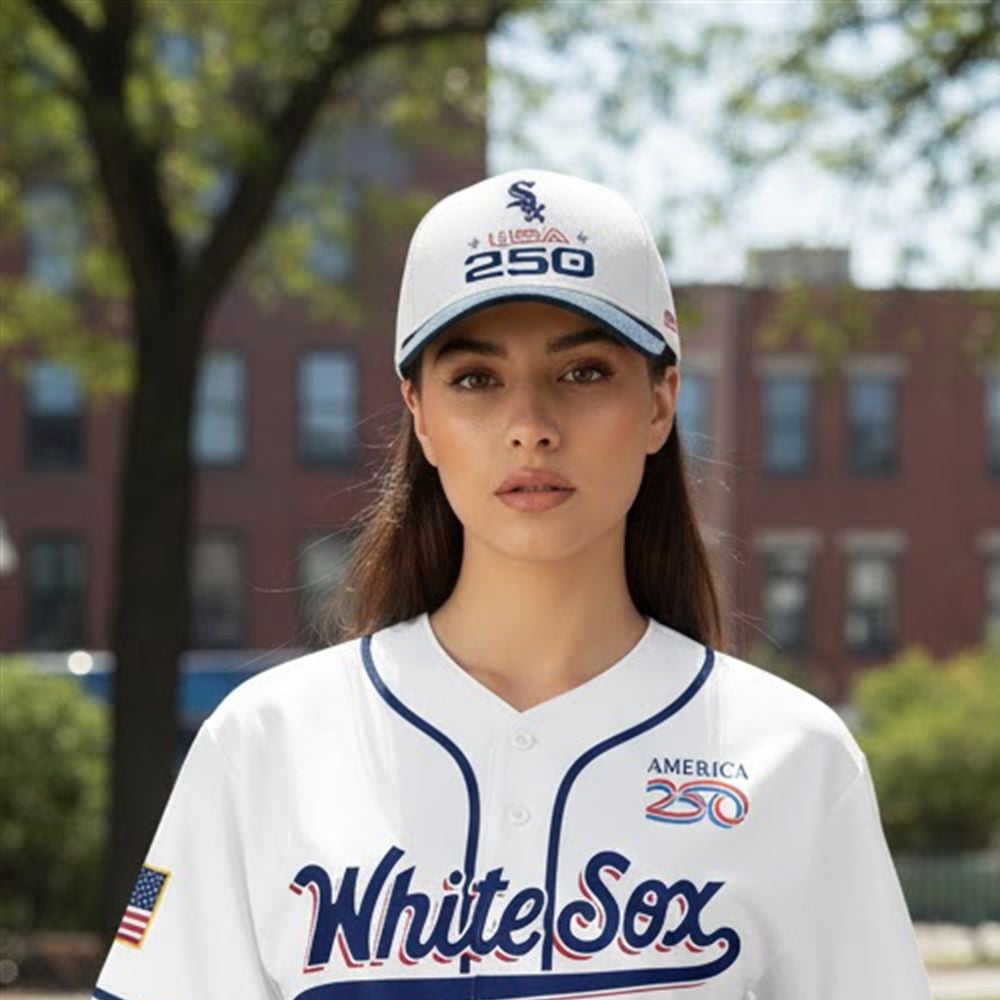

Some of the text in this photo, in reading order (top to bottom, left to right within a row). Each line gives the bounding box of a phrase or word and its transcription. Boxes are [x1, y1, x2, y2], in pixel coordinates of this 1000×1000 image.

[464, 247, 595, 283] 250
[647, 757, 749, 780] AMERICA
[645, 778, 749, 829] 250
[289, 846, 741, 976] White Sox
